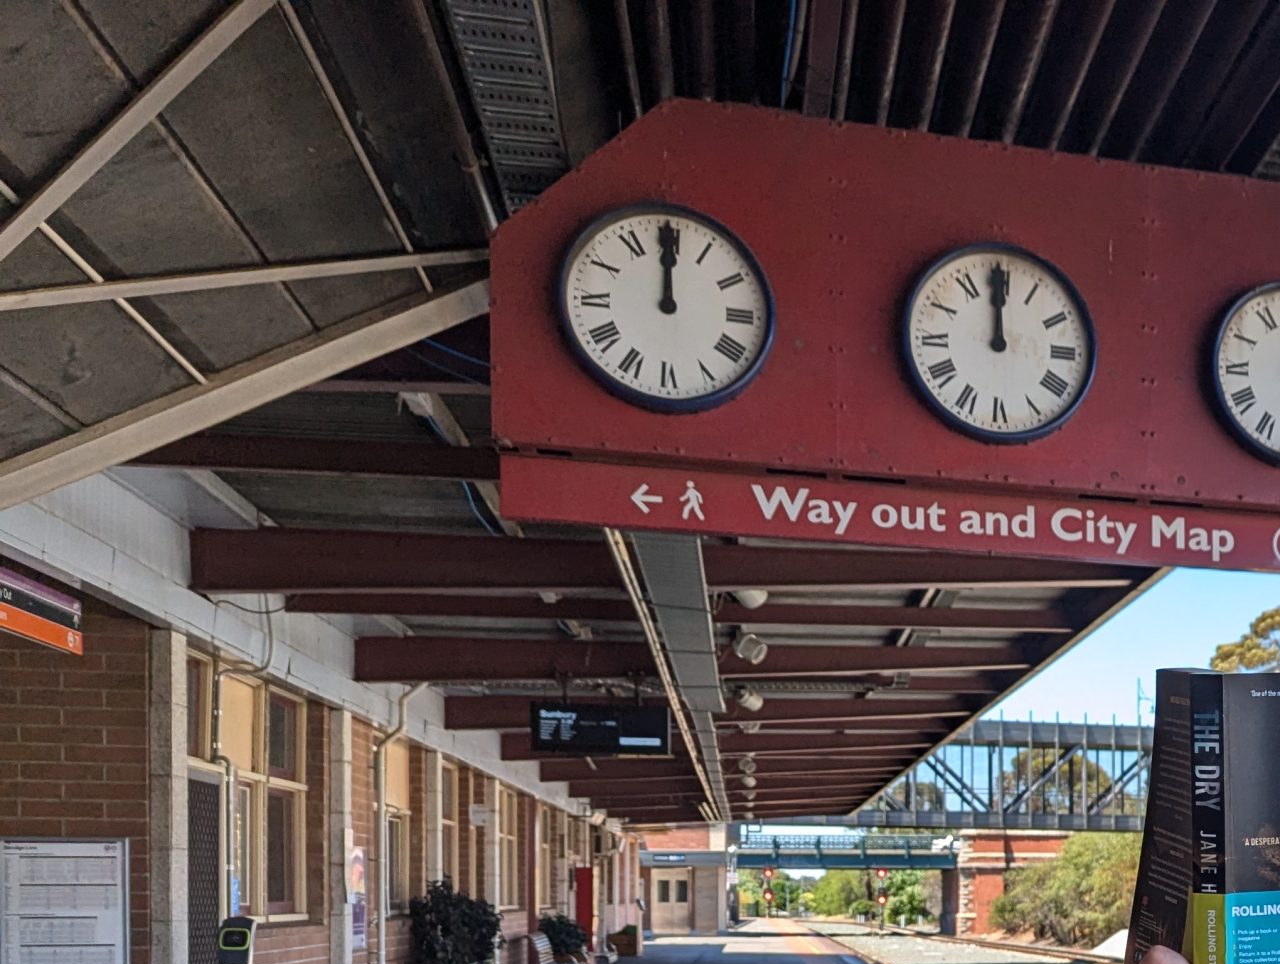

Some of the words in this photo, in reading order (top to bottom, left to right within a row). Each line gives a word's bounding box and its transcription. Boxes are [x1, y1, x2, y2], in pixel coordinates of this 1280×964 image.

[751, 484, 858, 535] Way
[871, 502, 946, 532] out
[959, 505, 1036, 538] and
[1051, 507, 1138, 555] City
[1152, 515, 1235, 562] Map
[1194, 710, 1220, 754] THE
[1195, 765, 1221, 811] DRY
[1200, 831, 1217, 874] JANE
[1245, 837, 1250, 846] A
[1207, 909, 1216, 952] ROLLING
